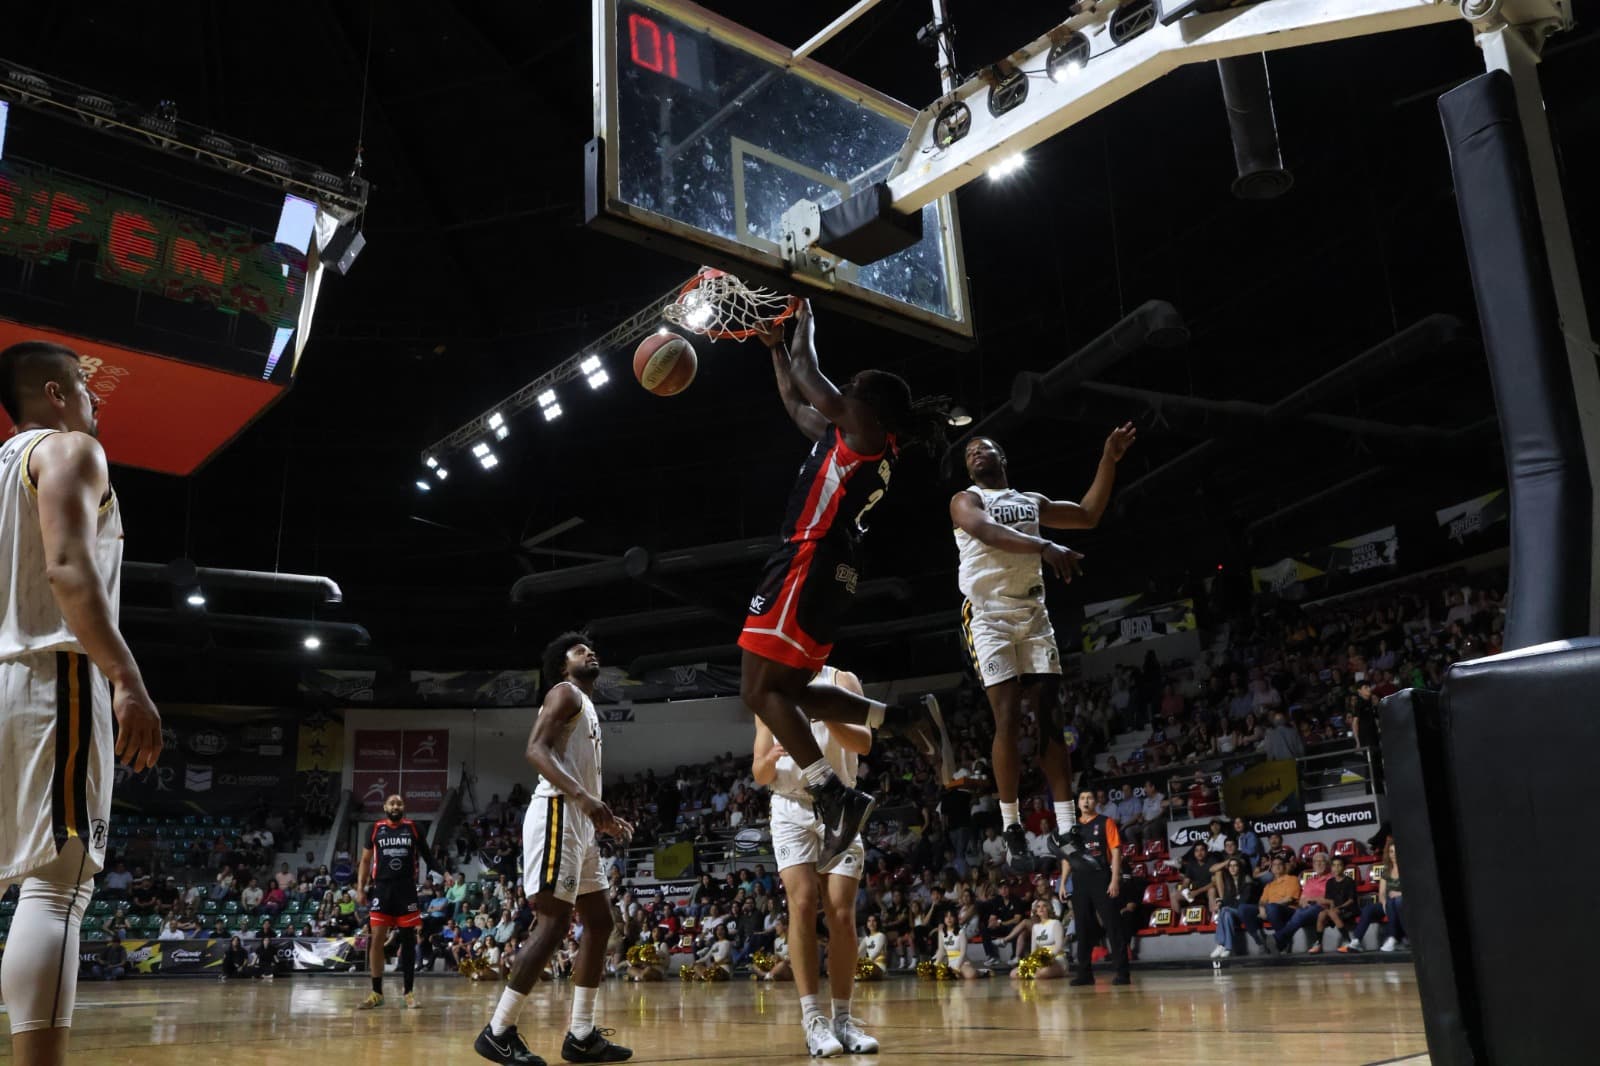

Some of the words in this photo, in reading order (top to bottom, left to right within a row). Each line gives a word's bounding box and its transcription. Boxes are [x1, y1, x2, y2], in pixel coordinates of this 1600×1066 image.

[990, 504, 1037, 525] RAYOS
[1325, 808, 1372, 825] Chevron
[1254, 818, 1297, 834] Chevron
[378, 836, 413, 848] TIJUANA
